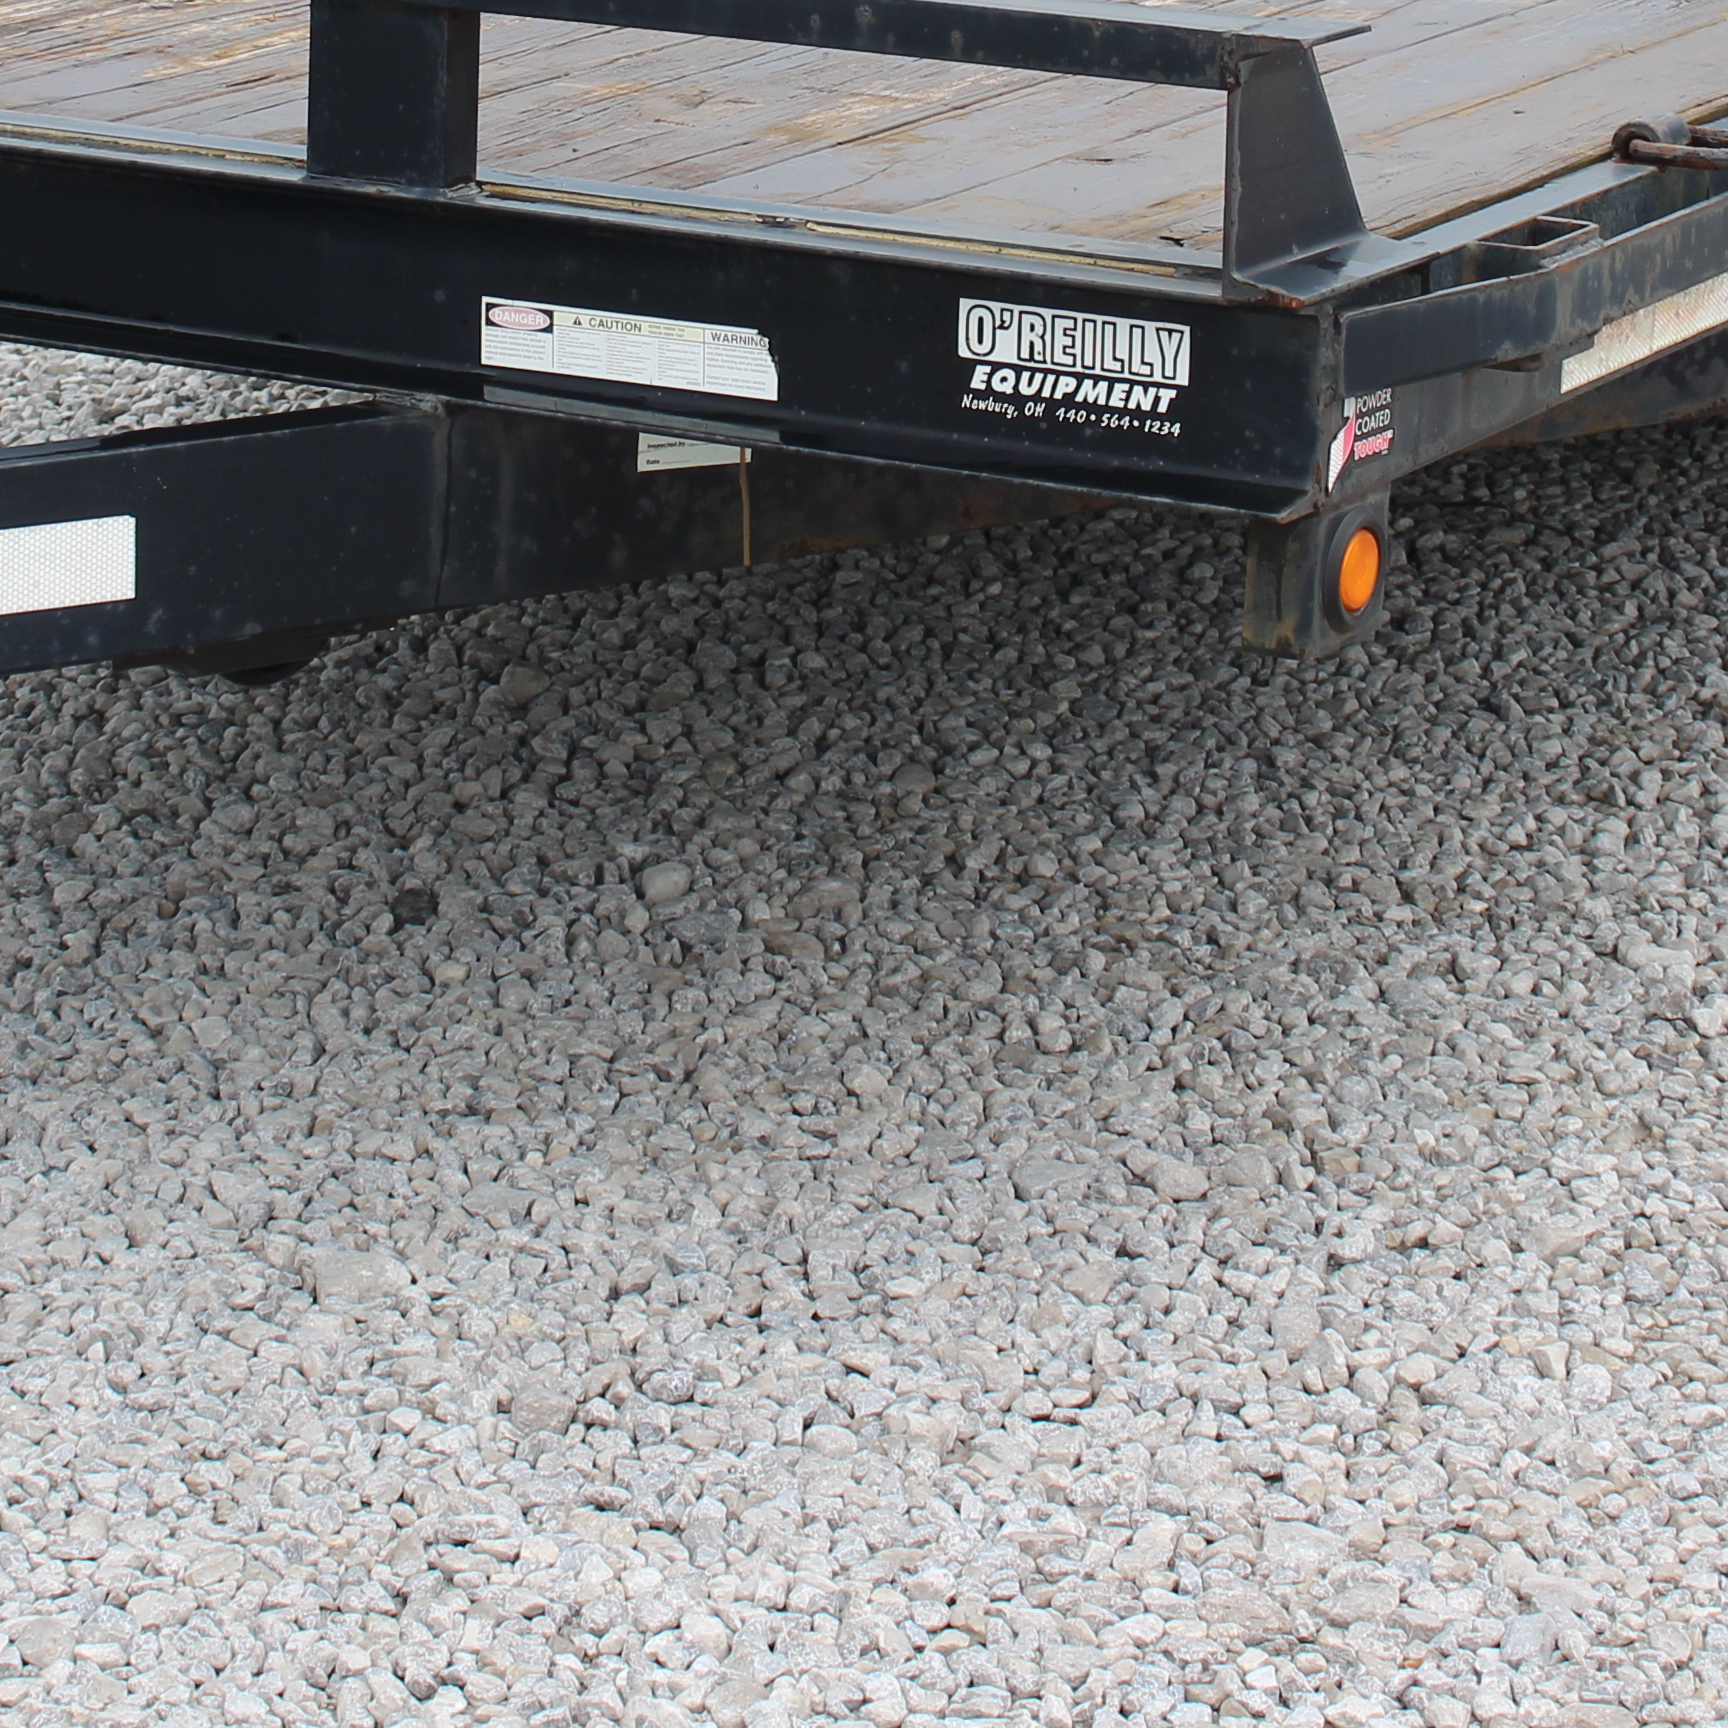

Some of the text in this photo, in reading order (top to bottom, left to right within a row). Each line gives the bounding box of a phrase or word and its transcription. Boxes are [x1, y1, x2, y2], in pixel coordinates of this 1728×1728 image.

[494, 310, 545, 326] DANGER
[588, 317, 642, 333] CAUTION
[710, 331, 767, 348] WARNING
[969, 364, 1177, 414] EQUIPMENT
[1356, 387, 1392, 414] POWDER
[961, 393, 1019, 419] Newbury,
[1024, 401, 1046, 418] OH
[1355, 408, 1391, 436] COATED
